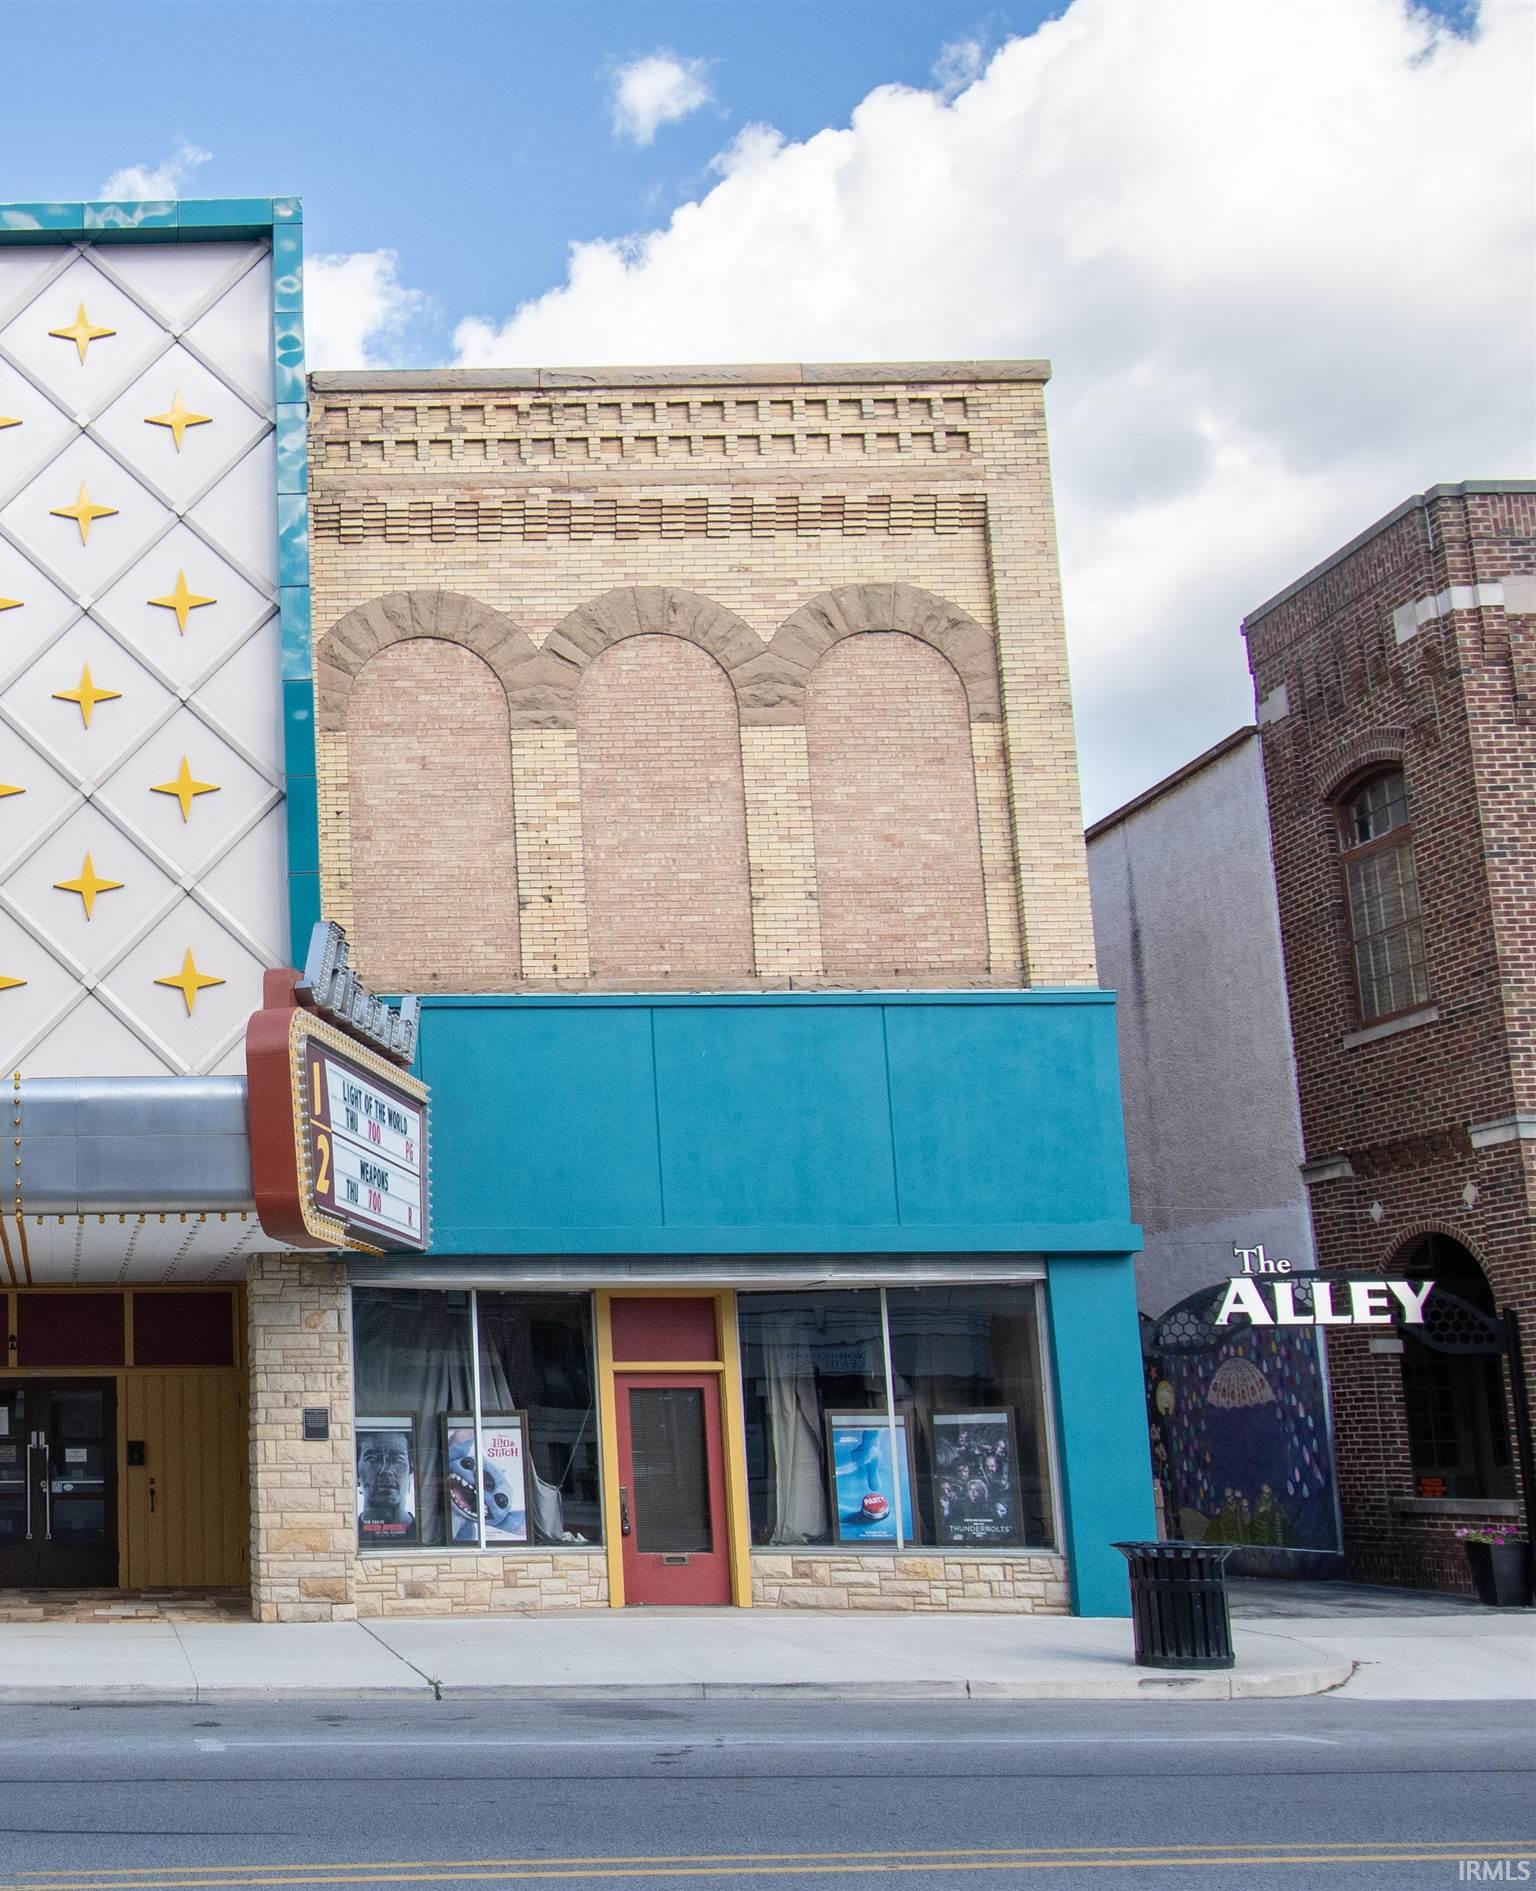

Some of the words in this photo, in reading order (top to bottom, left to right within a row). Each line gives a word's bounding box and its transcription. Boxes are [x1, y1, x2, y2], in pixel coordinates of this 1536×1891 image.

[312, 1061, 322, 1116] 1
[343, 1080, 362, 1110] LIGHT
[364, 1094, 373, 1116] OF
[375, 1099, 386, 1124] THE
[387, 1107, 408, 1136] WORLD
[345, 1106, 359, 1133] THU
[368, 1119, 381, 1145] 700
[405, 1140, 414, 1162] PG
[316, 1134, 330, 1195] 2
[360, 1159, 389, 1192] WEAPONS
[346, 1178, 359, 1204] THU
[368, 1188, 382, 1215] 700
[407, 1206, 413, 1227] R
[1233, 1244, 1292, 1275] The
[1215, 1277, 1436, 1325] ALLEY
[864, 1496, 887, 1506] PARTY
